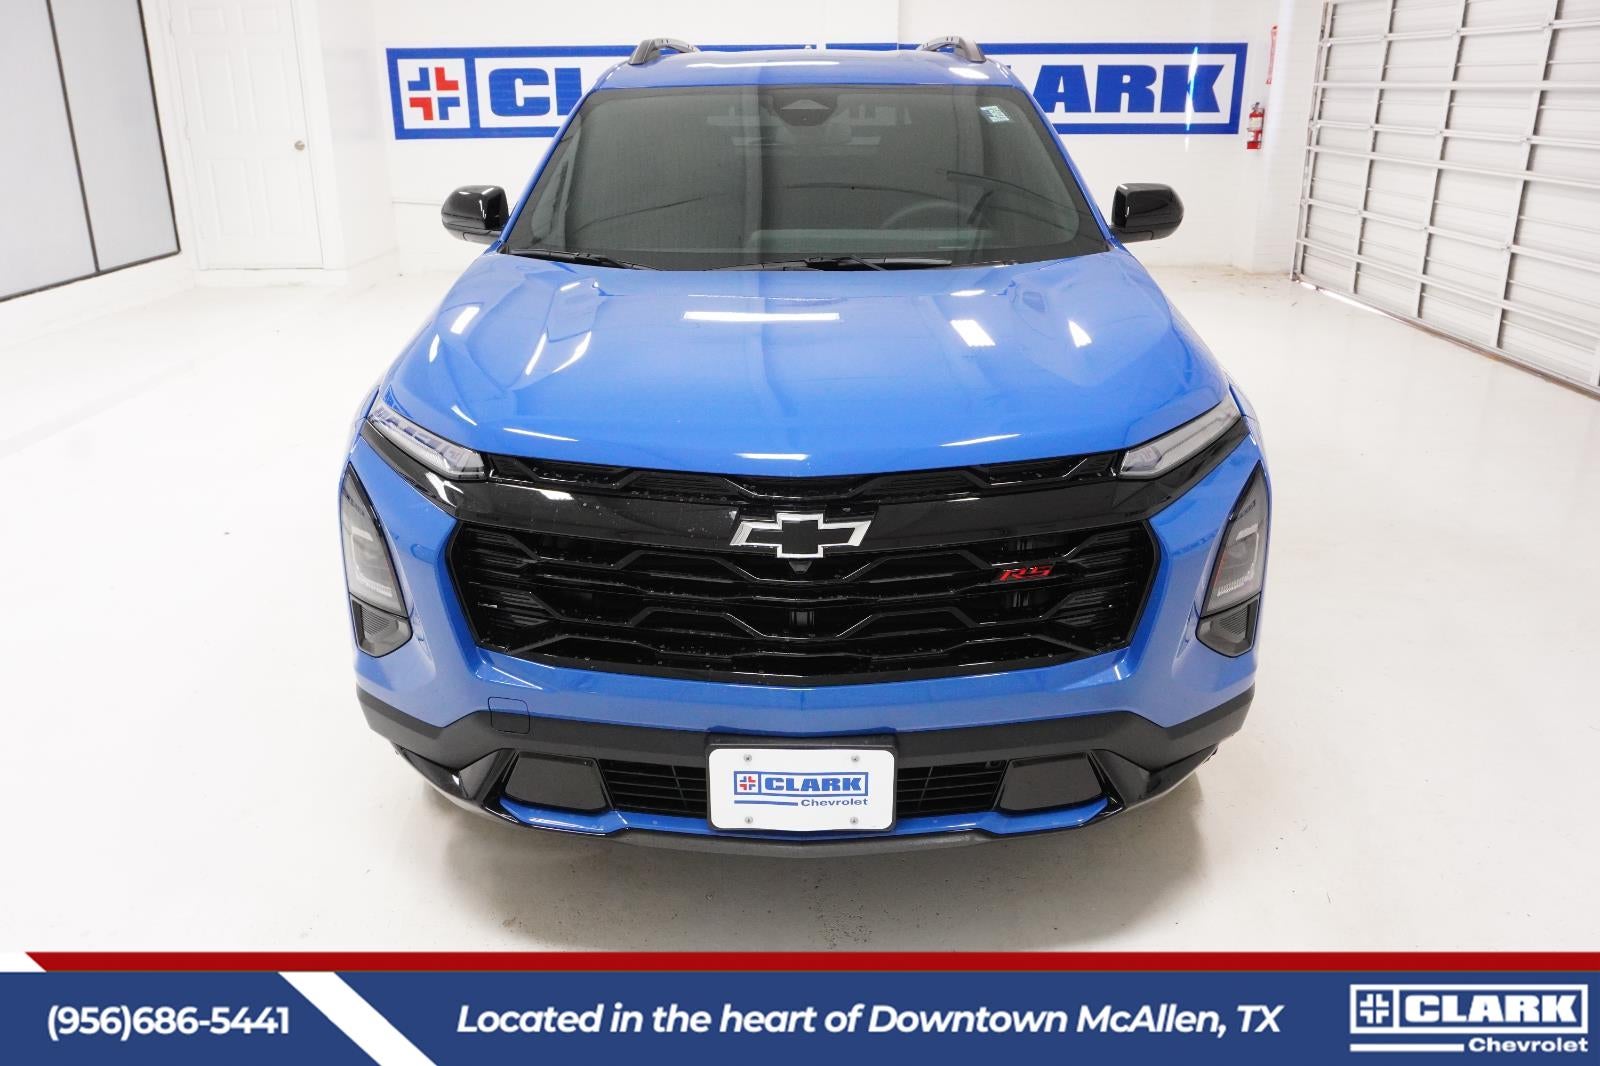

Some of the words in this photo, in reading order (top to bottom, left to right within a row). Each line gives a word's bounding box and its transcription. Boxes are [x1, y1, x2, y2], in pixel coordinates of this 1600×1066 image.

[1007, 64, 1225, 114] ARK
[999, 565, 1055, 582] RS
[764, 777, 862, 792] CLARK
[800, 798, 869, 808] Chevrolet
